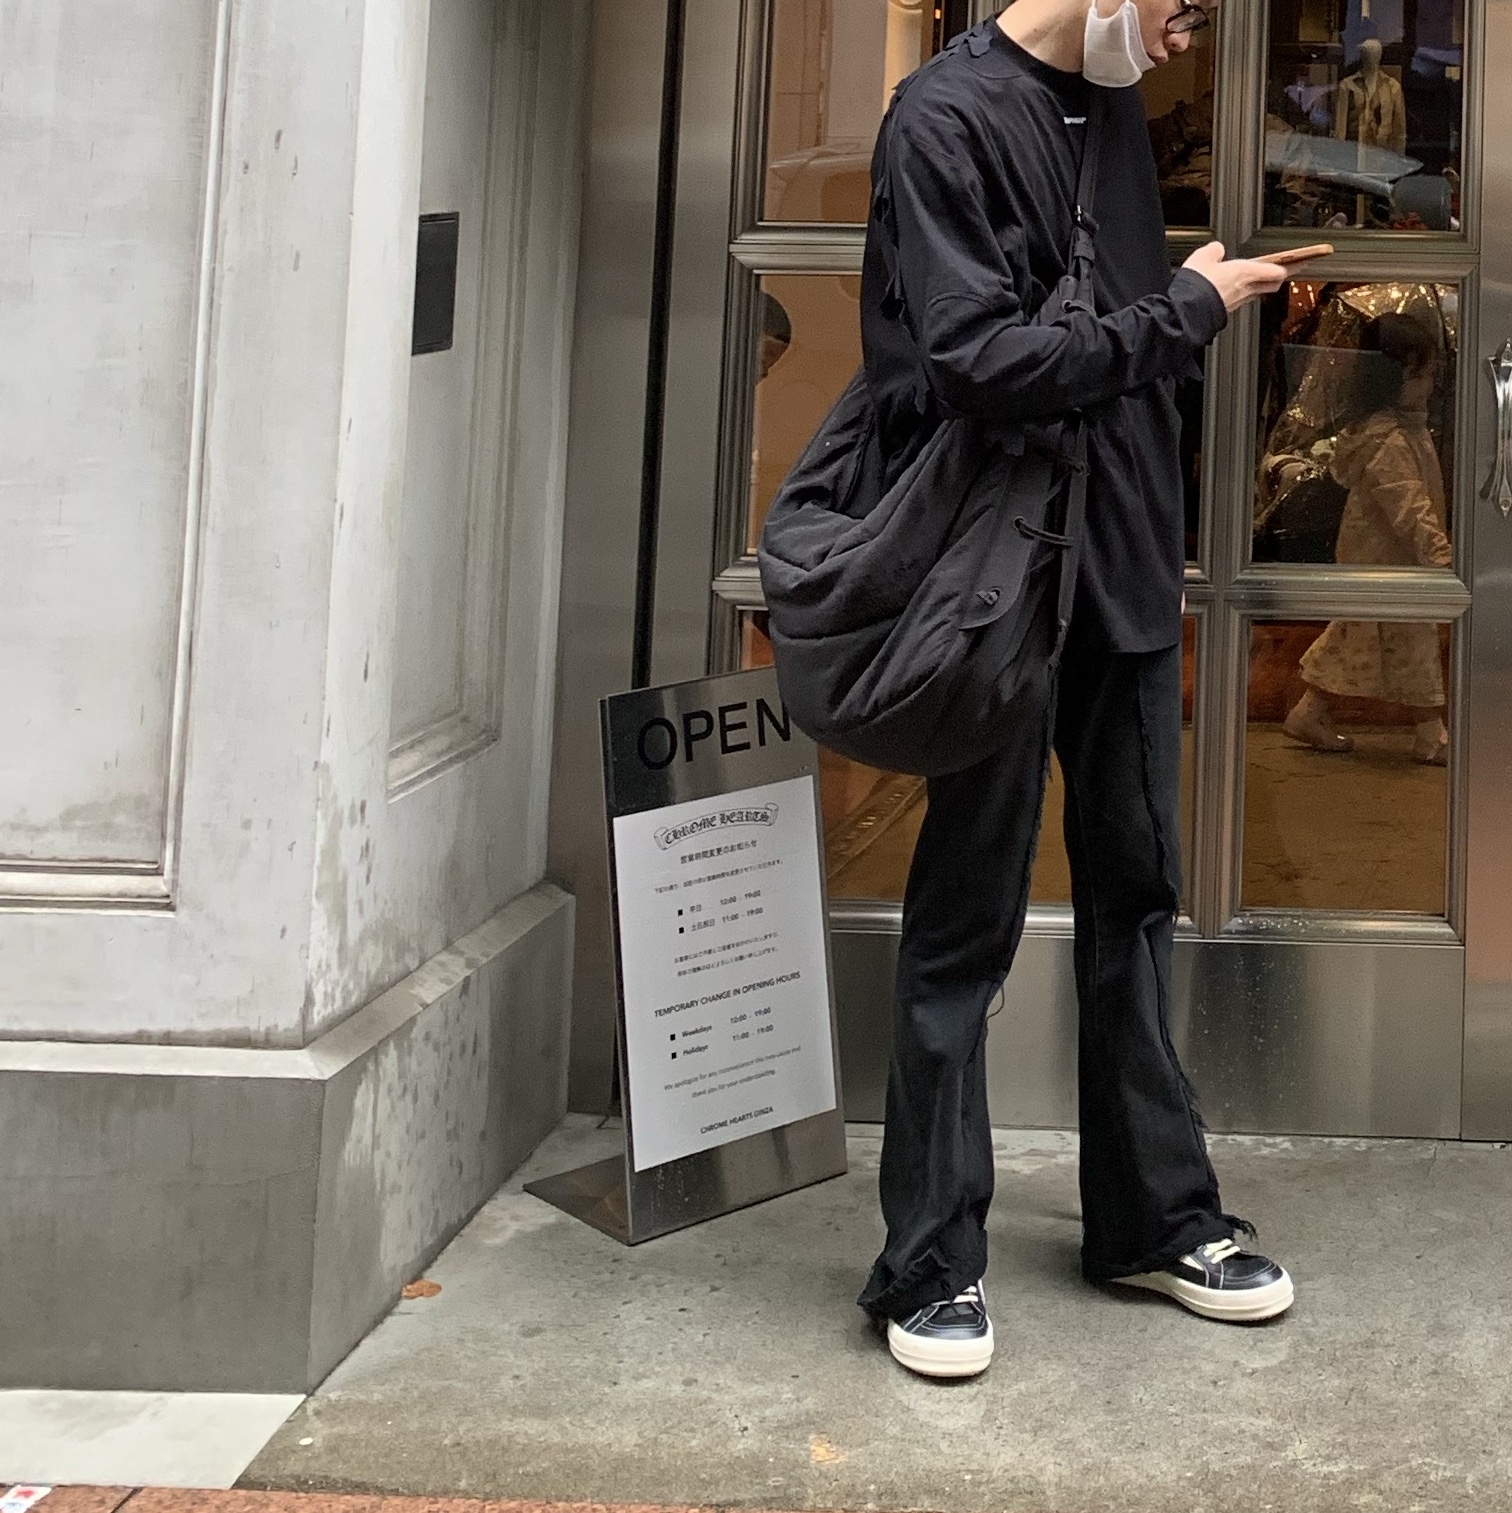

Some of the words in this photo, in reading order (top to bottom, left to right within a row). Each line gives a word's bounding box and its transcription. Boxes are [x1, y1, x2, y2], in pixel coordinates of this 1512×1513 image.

[637, 698, 791, 770] OPEN
[655, 1000, 698, 1017] TEMPORARY
[700, 990, 731, 1005] CHANGE
[733, 988, 741, 996] IN
[742, 978, 775, 993] OPENING
[776, 971, 801, 984] HOURS
[682, 1026, 712, 1037] Weekdays
[730, 1014, 747, 1023] 12:00
[683, 1045, 708, 1055] Holidays
[700, 1120, 728, 1134] CHROME
[729, 1112, 753, 1124] HEARTS
[754, 1107, 773, 1117] GINZA
